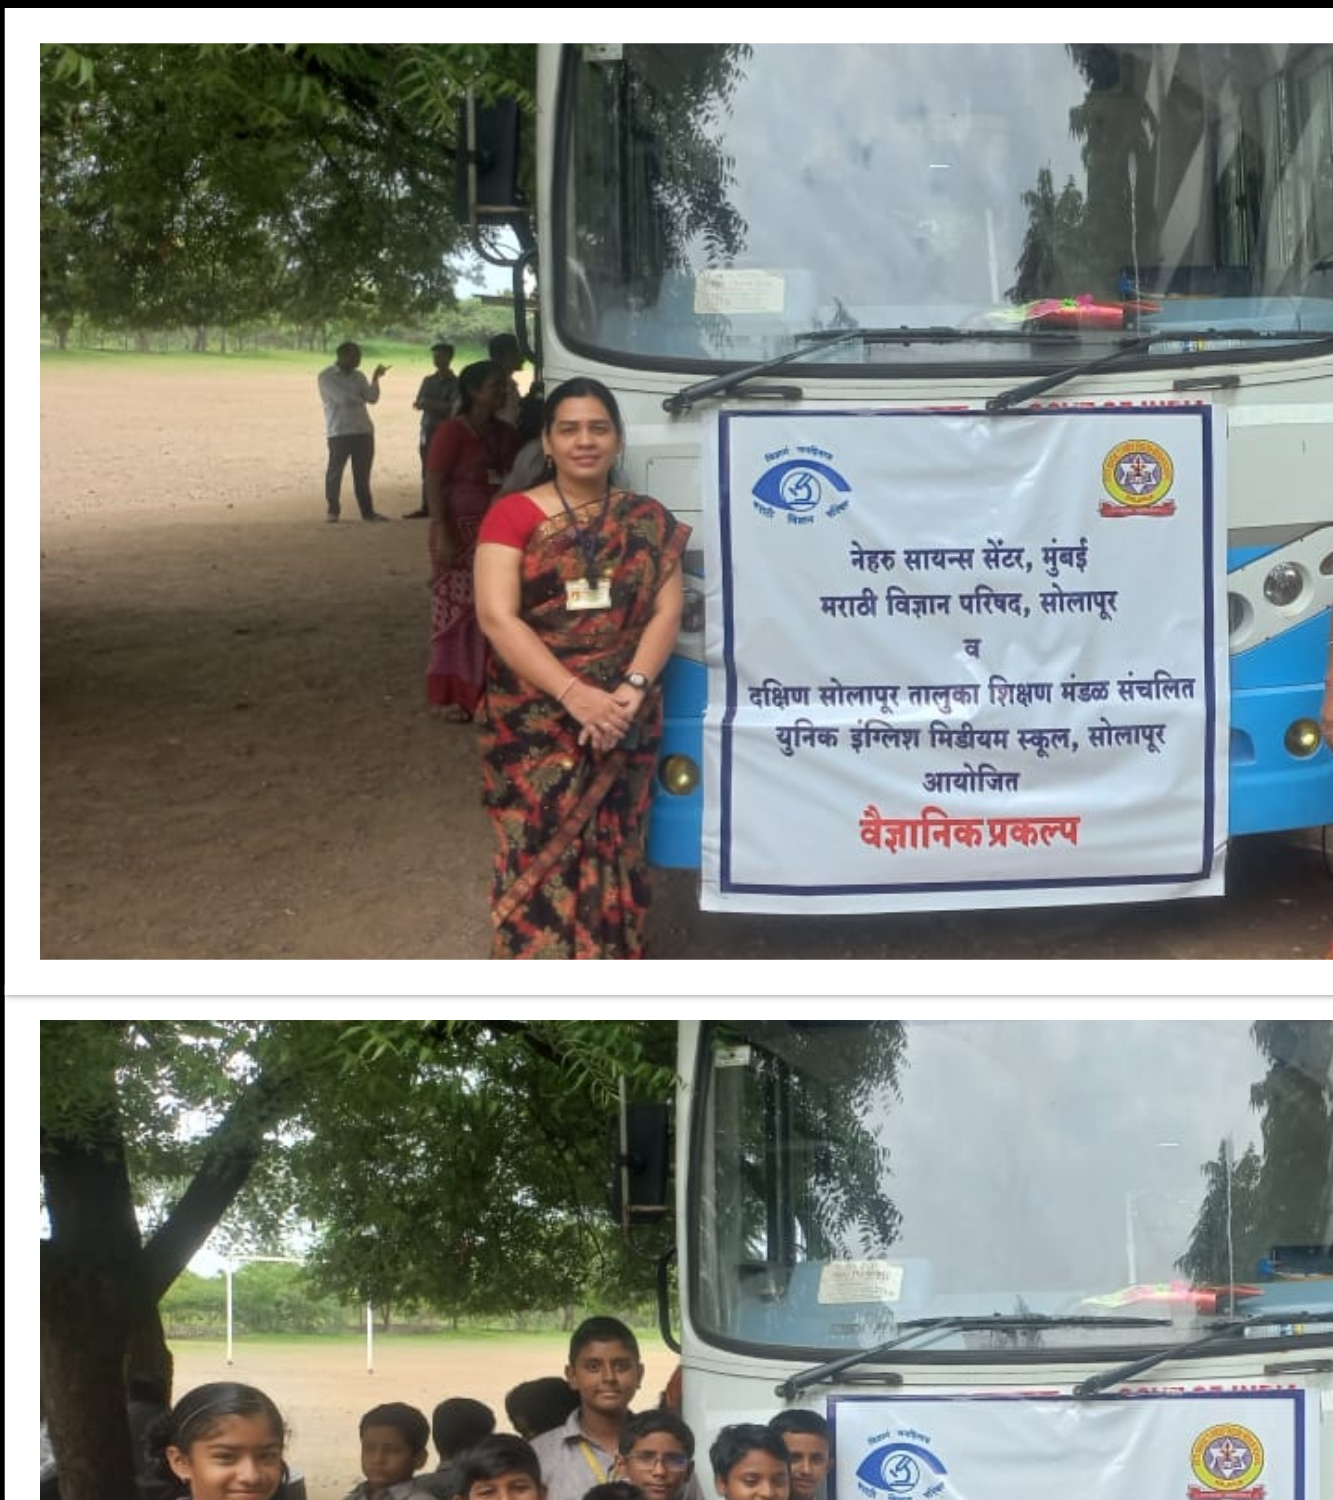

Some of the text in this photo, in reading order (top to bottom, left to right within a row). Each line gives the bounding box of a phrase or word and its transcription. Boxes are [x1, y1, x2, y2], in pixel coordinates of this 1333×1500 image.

[850, 537, 1088, 577] नेहरु सायन्स सेंटर, मुंबई
[820, 583, 1118, 620] मराठी विज्ञान परिषद, सोलापूर
[963, 639, 982, 659] व
[748, 669, 1195, 713] दक्षिण सोलापूर तालुका शिक्षण मंडळ संचलित
[775, 717, 1166, 758] युनिक इंग्लिश मिडीयम स्कूल, सोलापूर
[923, 762, 1021, 792] आयोजित
[859, 805, 1081, 854] वैज्ञानिक प्रकल्प
